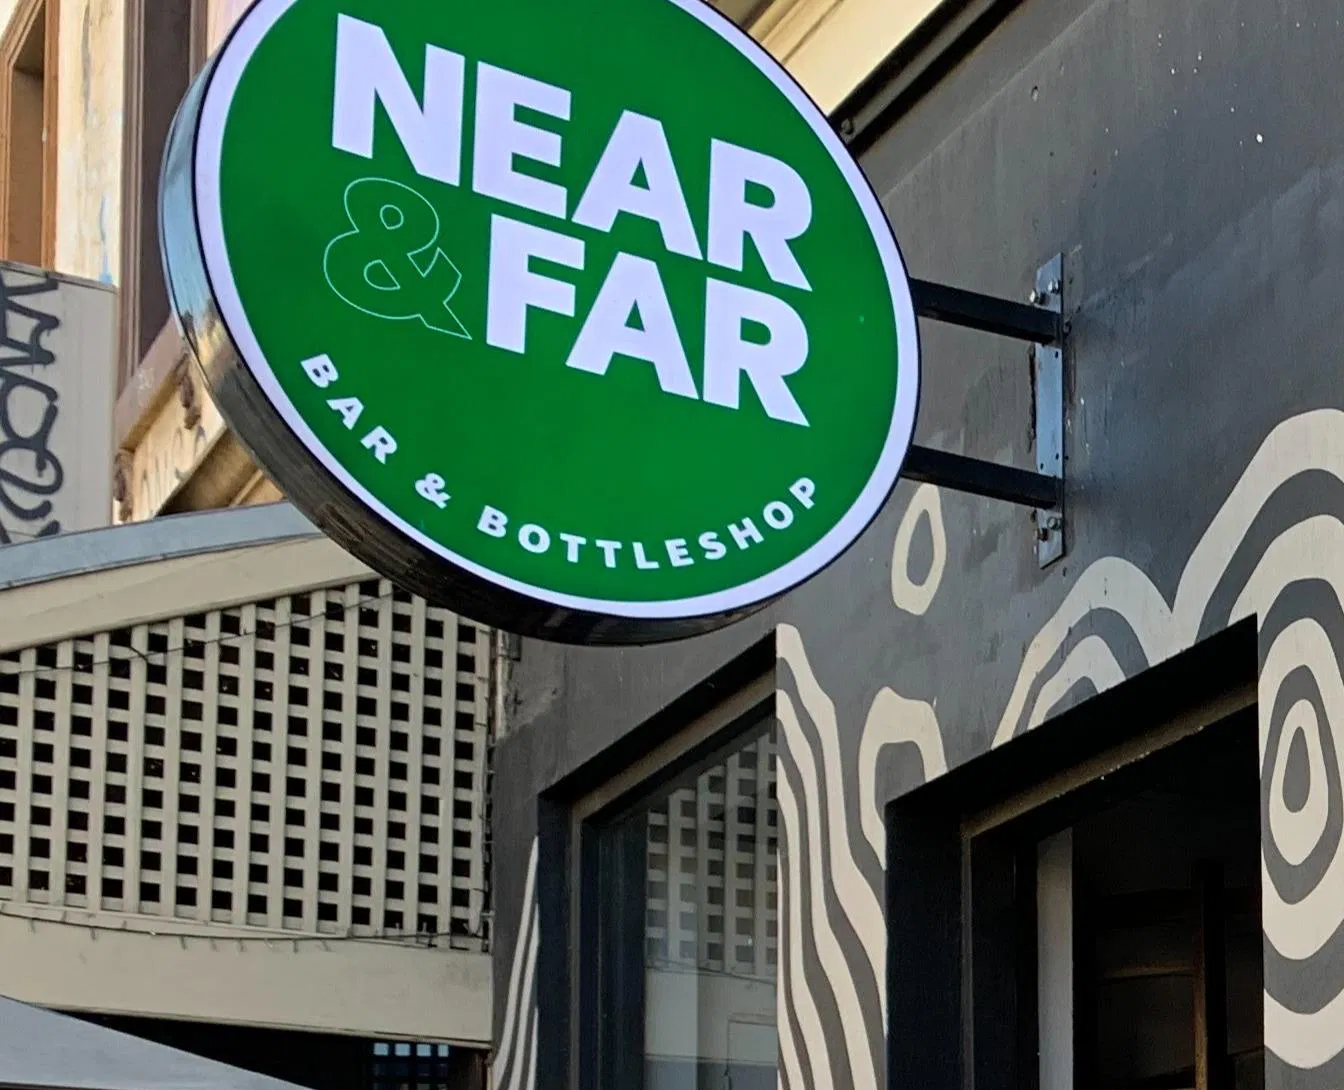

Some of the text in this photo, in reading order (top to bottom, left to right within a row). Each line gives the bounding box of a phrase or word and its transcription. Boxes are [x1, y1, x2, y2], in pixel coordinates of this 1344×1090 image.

[331, 12, 813, 292] NEAR
[323, 176, 811, 428] & FAR
[300, 352, 819, 571] BAR & BOTTLESHOP
